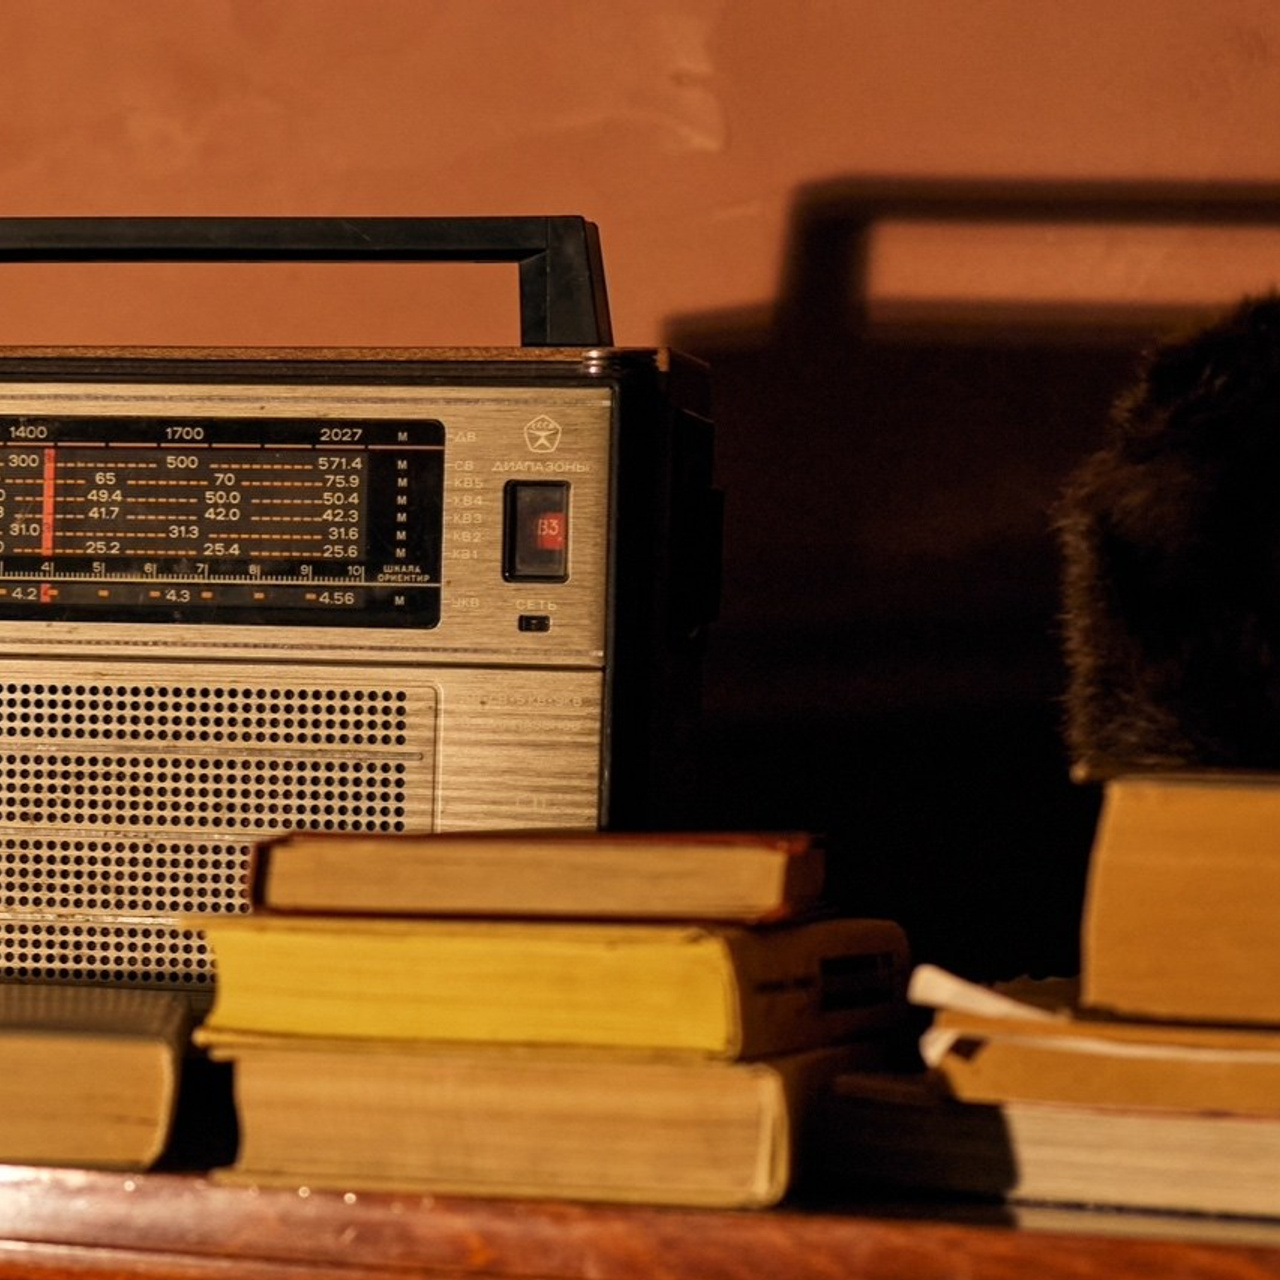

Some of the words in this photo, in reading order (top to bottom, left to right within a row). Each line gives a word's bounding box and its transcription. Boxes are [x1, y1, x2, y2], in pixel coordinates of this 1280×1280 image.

[9, 426, 48, 439] 1400
[165, 427, 205, 440] 1700
[319, 428, 363, 441] 2027
[398, 432, 408, 441] М
[8, 455, 39, 467] 300
[166, 456, 199, 468] 500
[318, 457, 362, 470] 571.4
[397, 460, 408, 470] М
[454, 461, 475, 471] СВ
[491, 461, 591, 473] ДИАПАЗОНЫ
[95, 472, 116, 485] 65
[214, 473, 236, 486] 70
[324, 475, 360, 488] 75.9
[397, 477, 408, 487] М
[454, 479, 484, 489] КВ5
[87, 489, 123, 502] 49.4
[205, 491, 241, 504] 50.0
[322, 492, 360, 505] 50.4
[396, 496, 407, 505] М
[88, 507, 120, 520] 41.7
[204, 508, 241, 521] 42.0
[322, 509, 359, 522] 42.3
[396, 513, 407, 523] М
[453, 514, 483, 524] КВ3
[9, 524, 40, 536] 31.0
[169, 525, 199, 538] 31.3
[328, 527, 359, 540] 31.6
[396, 531, 407, 540] М
[453, 532, 483, 542] КВ2
[85, 541, 120, 554] 25.2
[203, 543, 241, 556] 25.4
[323, 545, 358, 558] 25.6
[395, 548, 406, 558] М
[41, 561, 50, 571] 4
[92, 562, 101, 572] 5
[144, 563, 153, 573] 6
[196, 563, 204, 573] 7
[248, 564, 257, 575] 8
[300, 564, 308, 575] 9
[347, 565, 361, 576] 10
[383, 565, 422, 573] ШКАЛА
[377, 574, 431, 582] ОРИЕНТИР
[11, 587, 37, 600] 4.2
[165, 589, 190, 602] 4.3
[318, 592, 355, 605] 4.56
[394, 596, 405, 606] М
[515, 599, 557, 612] СЕТЬ
